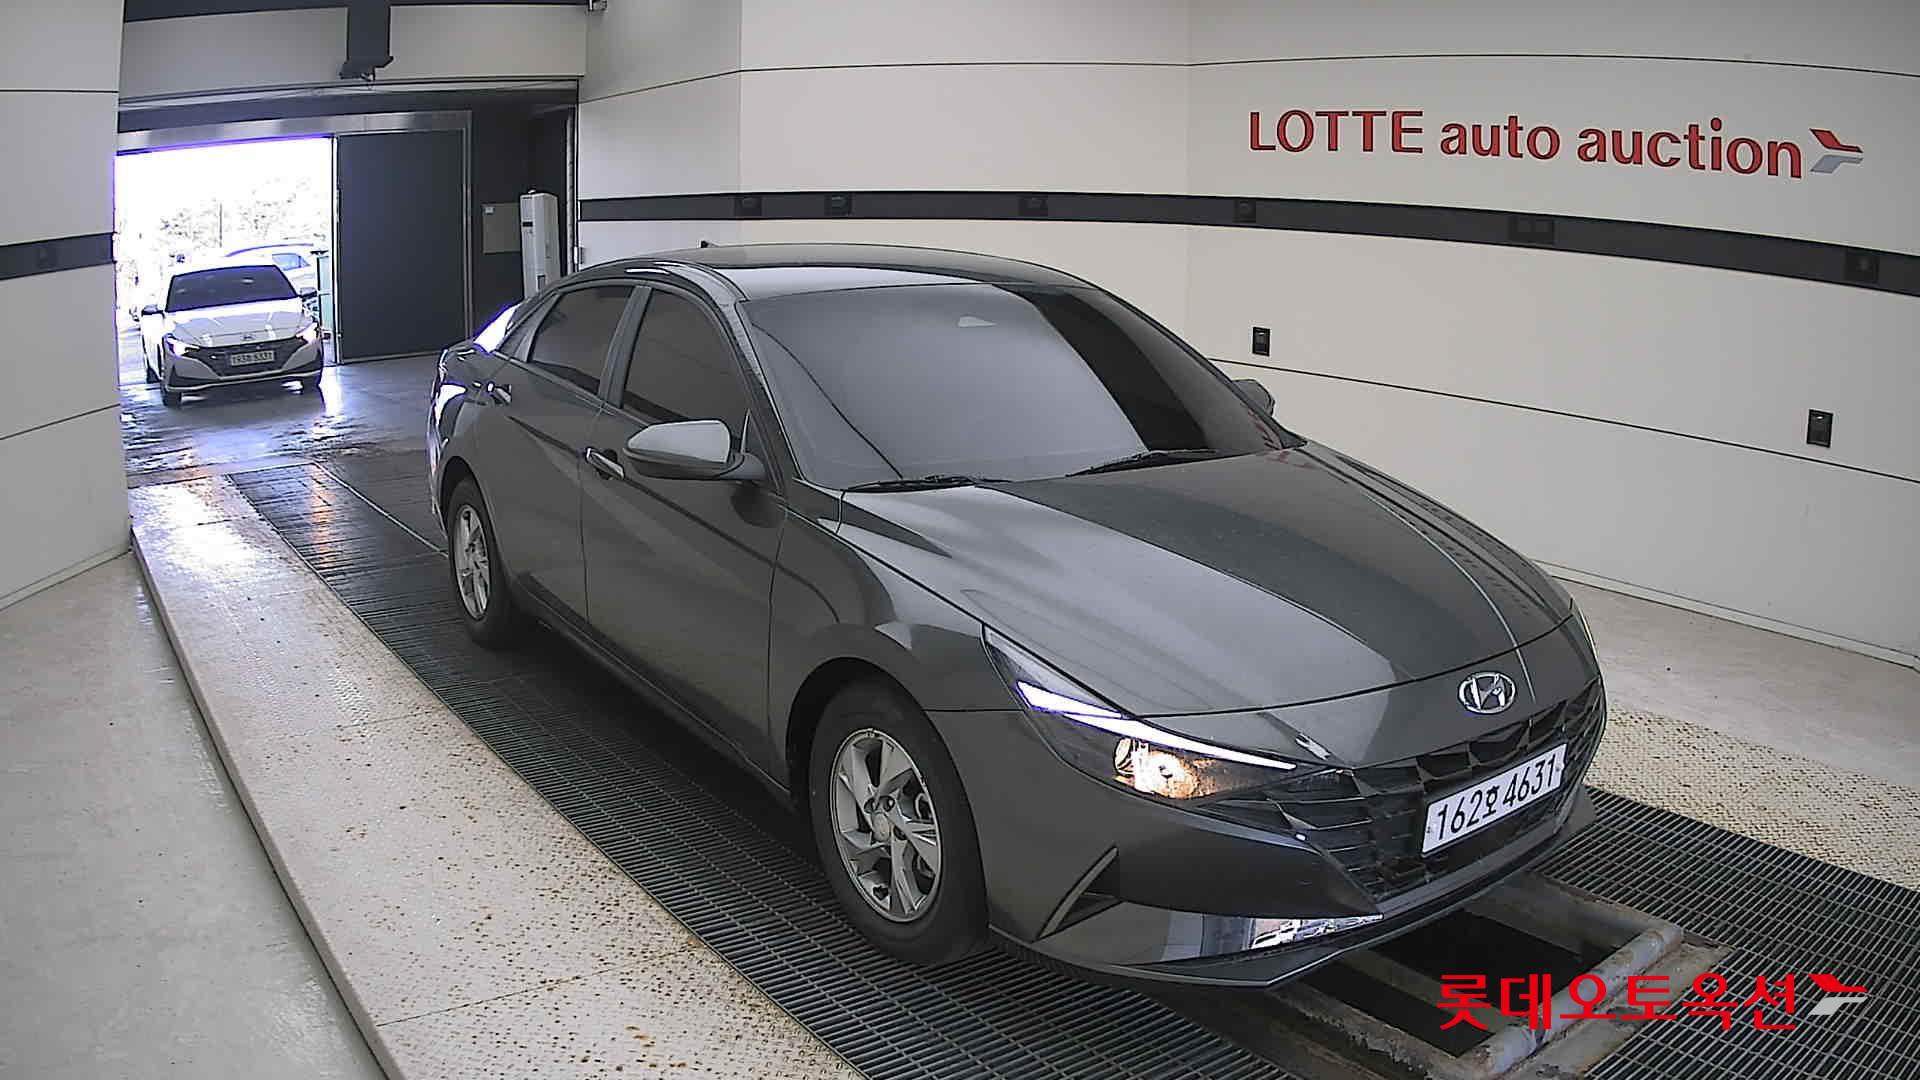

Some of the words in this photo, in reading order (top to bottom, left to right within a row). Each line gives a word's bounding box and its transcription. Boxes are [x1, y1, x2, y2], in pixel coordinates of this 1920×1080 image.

[1249, 110, 1423, 153] LOTTE
[1440, 115, 1560, 159] auto
[1577, 117, 1802, 178] auction
